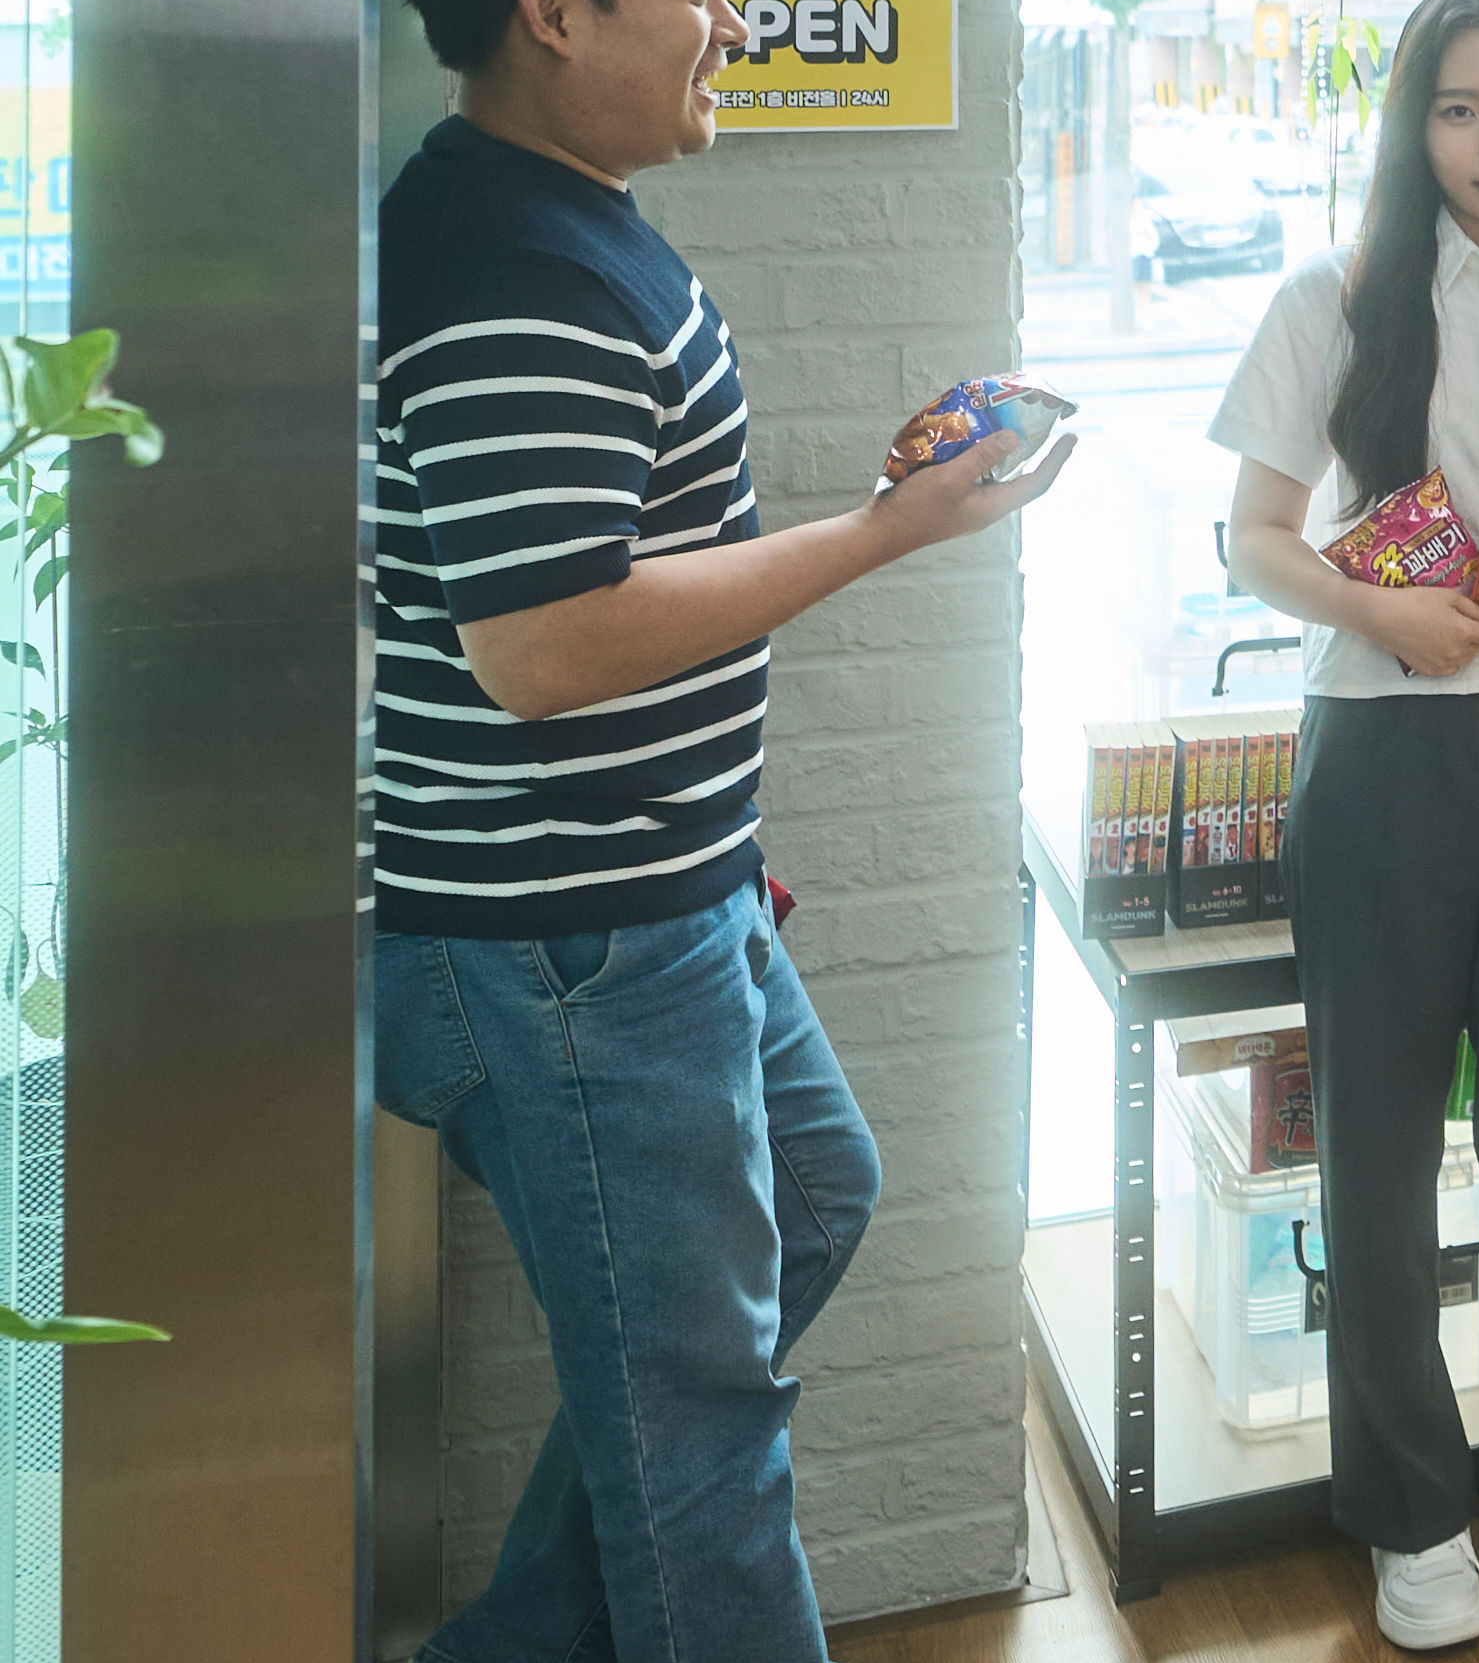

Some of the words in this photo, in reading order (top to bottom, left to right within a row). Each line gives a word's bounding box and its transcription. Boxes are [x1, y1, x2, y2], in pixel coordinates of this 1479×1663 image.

[756, 88, 785, 108] 1층
[786, 88, 841, 109] 비전홀
[850, 88, 890, 108] 24시
[1185, 897, 1249, 913] SLAMDUNK
[1089, 909, 1157, 923] SLAMDUNK
